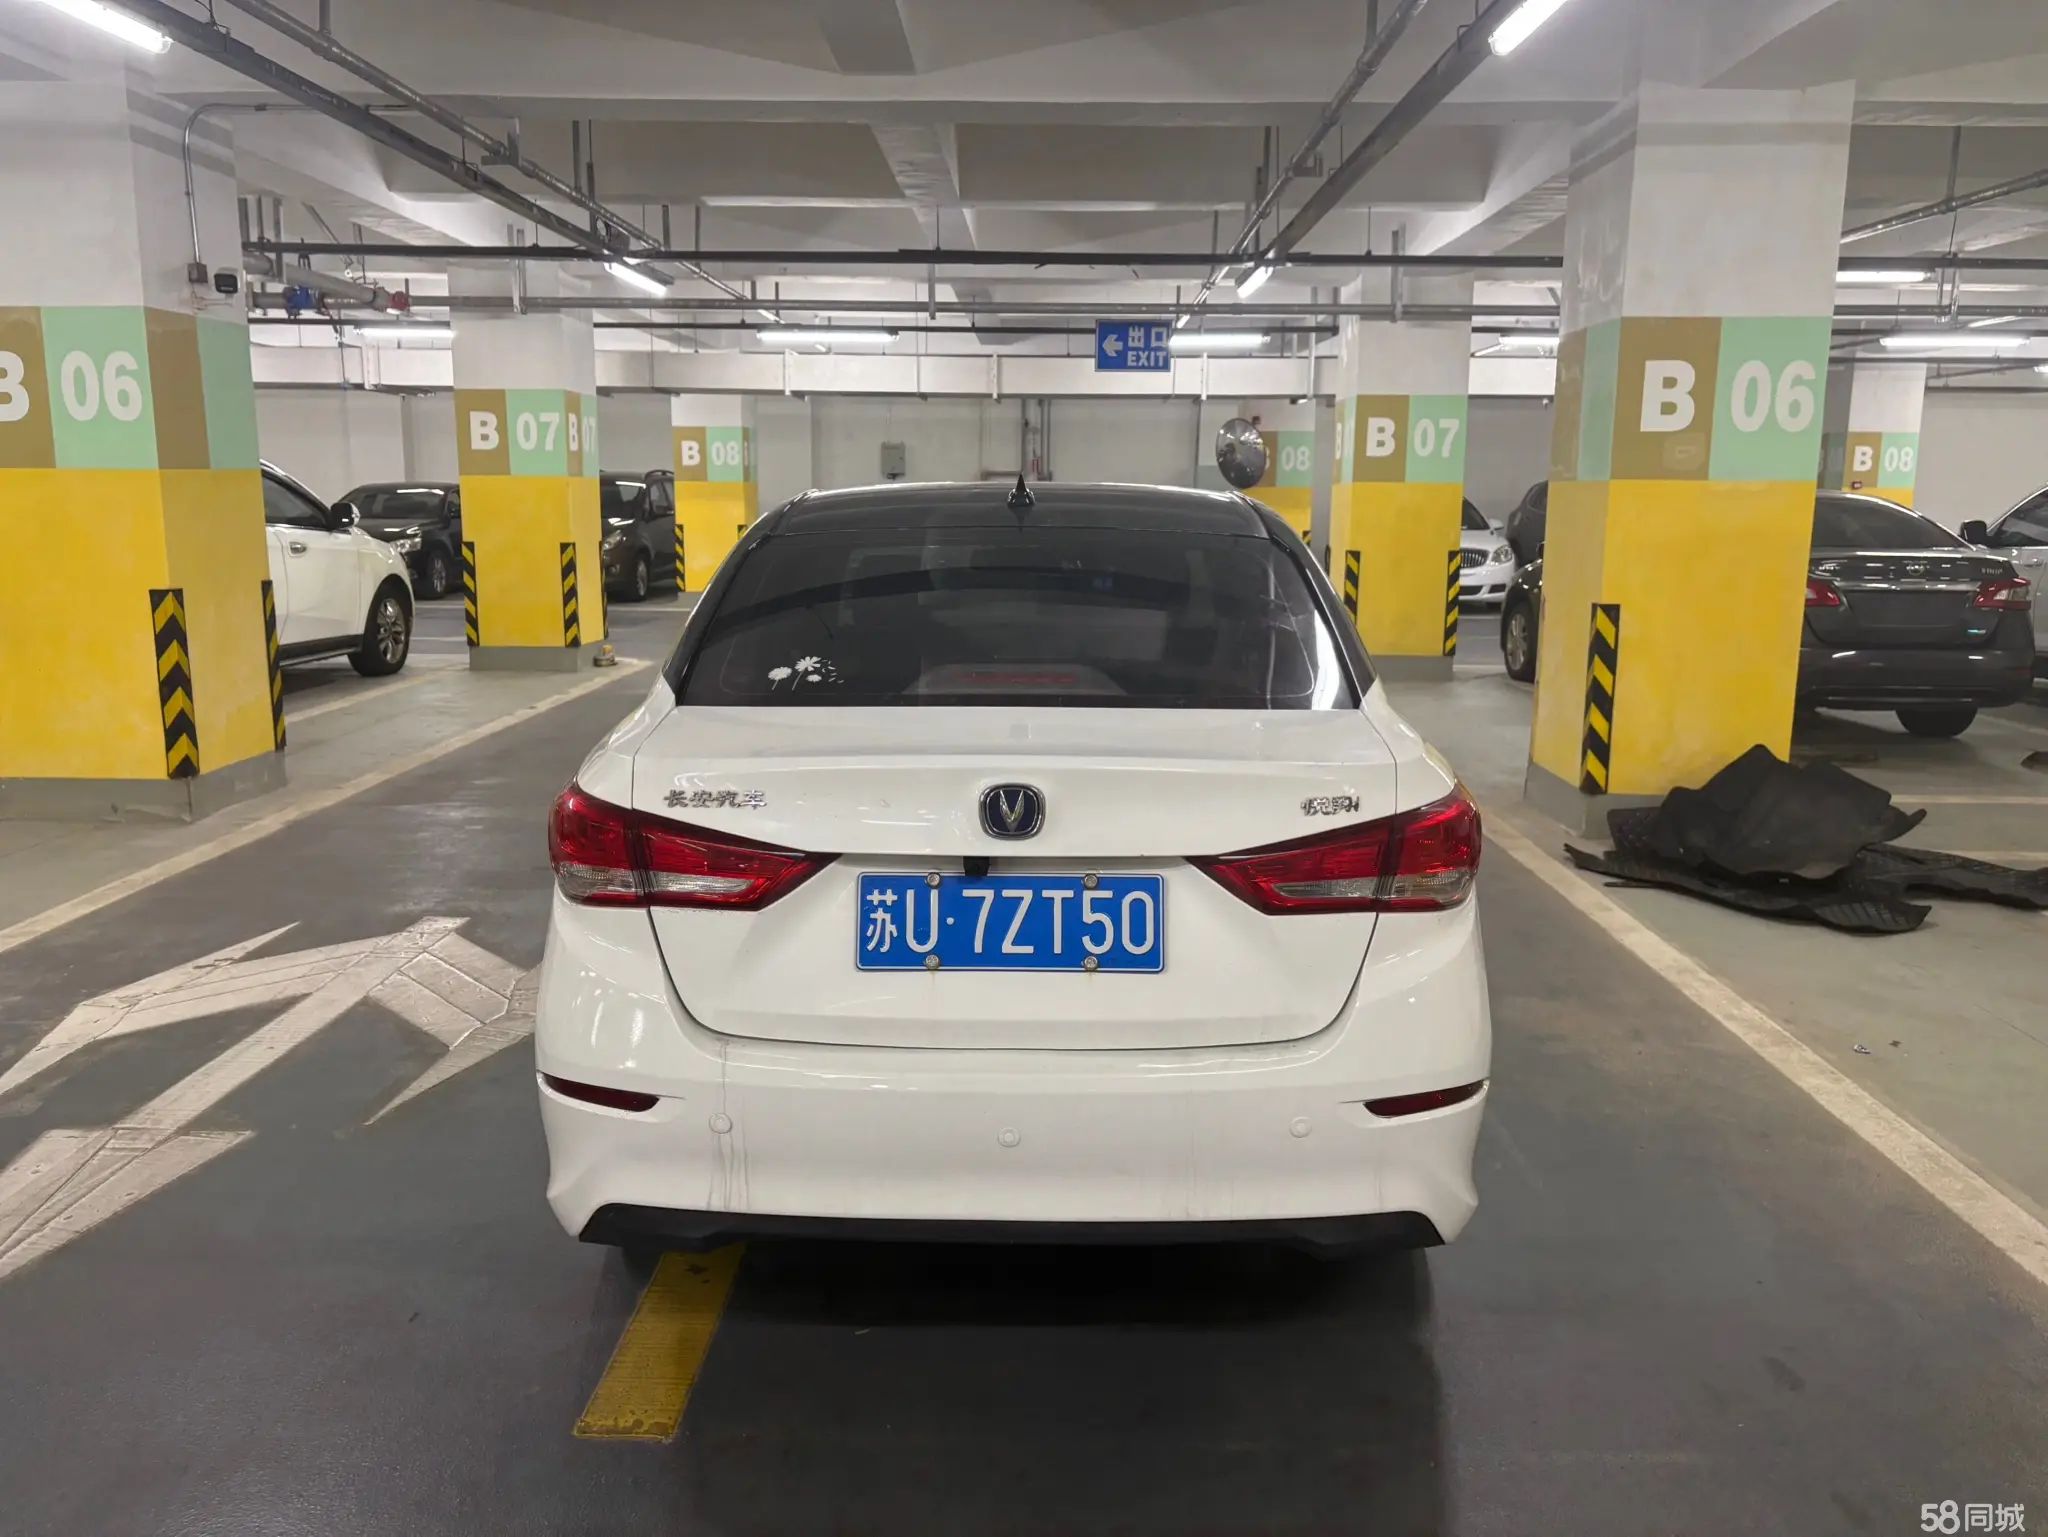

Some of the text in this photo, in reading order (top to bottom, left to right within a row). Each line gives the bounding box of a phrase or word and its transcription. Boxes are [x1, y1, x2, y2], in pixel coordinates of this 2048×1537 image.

[1128, 325, 1167, 348] 出口
[1127, 350, 1166, 367] EXIT
[61, 350, 143, 422] 06
[1640, 359, 1816, 433] B 06
[469, 410, 560, 452] B 07
[568, 412, 579, 452] B
[1365, 416, 1396, 458] B
[1413, 417, 1460, 459] 07
[681, 440, 701, 467] B
[711, 440, 740, 466] 08
[1281, 445, 1311, 472] 08
[1852, 445, 1873, 472] B
[1884, 446, 1914, 473] 08
[663, 788, 768, 810] 长安汽车
[866, 889, 1155, 955] 苏U·7ZT50
